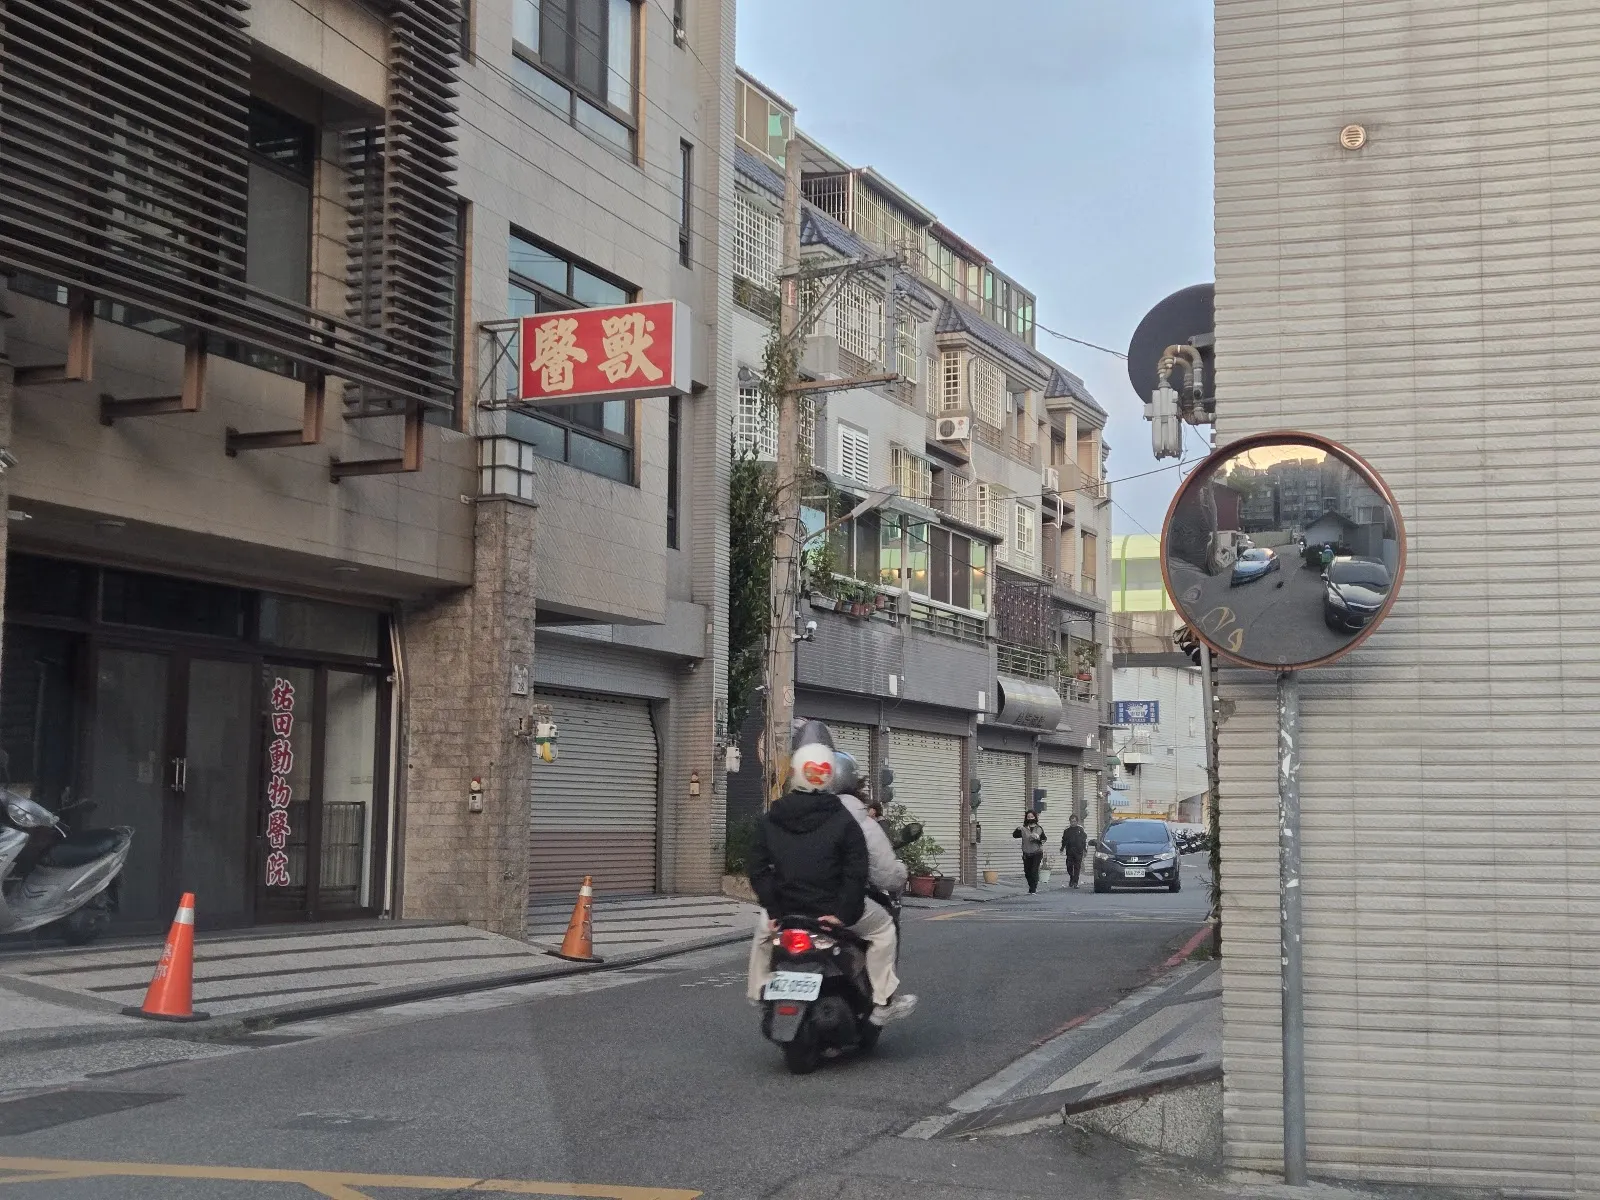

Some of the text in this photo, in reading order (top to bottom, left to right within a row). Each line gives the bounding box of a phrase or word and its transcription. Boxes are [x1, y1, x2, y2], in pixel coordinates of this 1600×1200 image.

[266, 677, 295, 887] 祐田動物醫院
